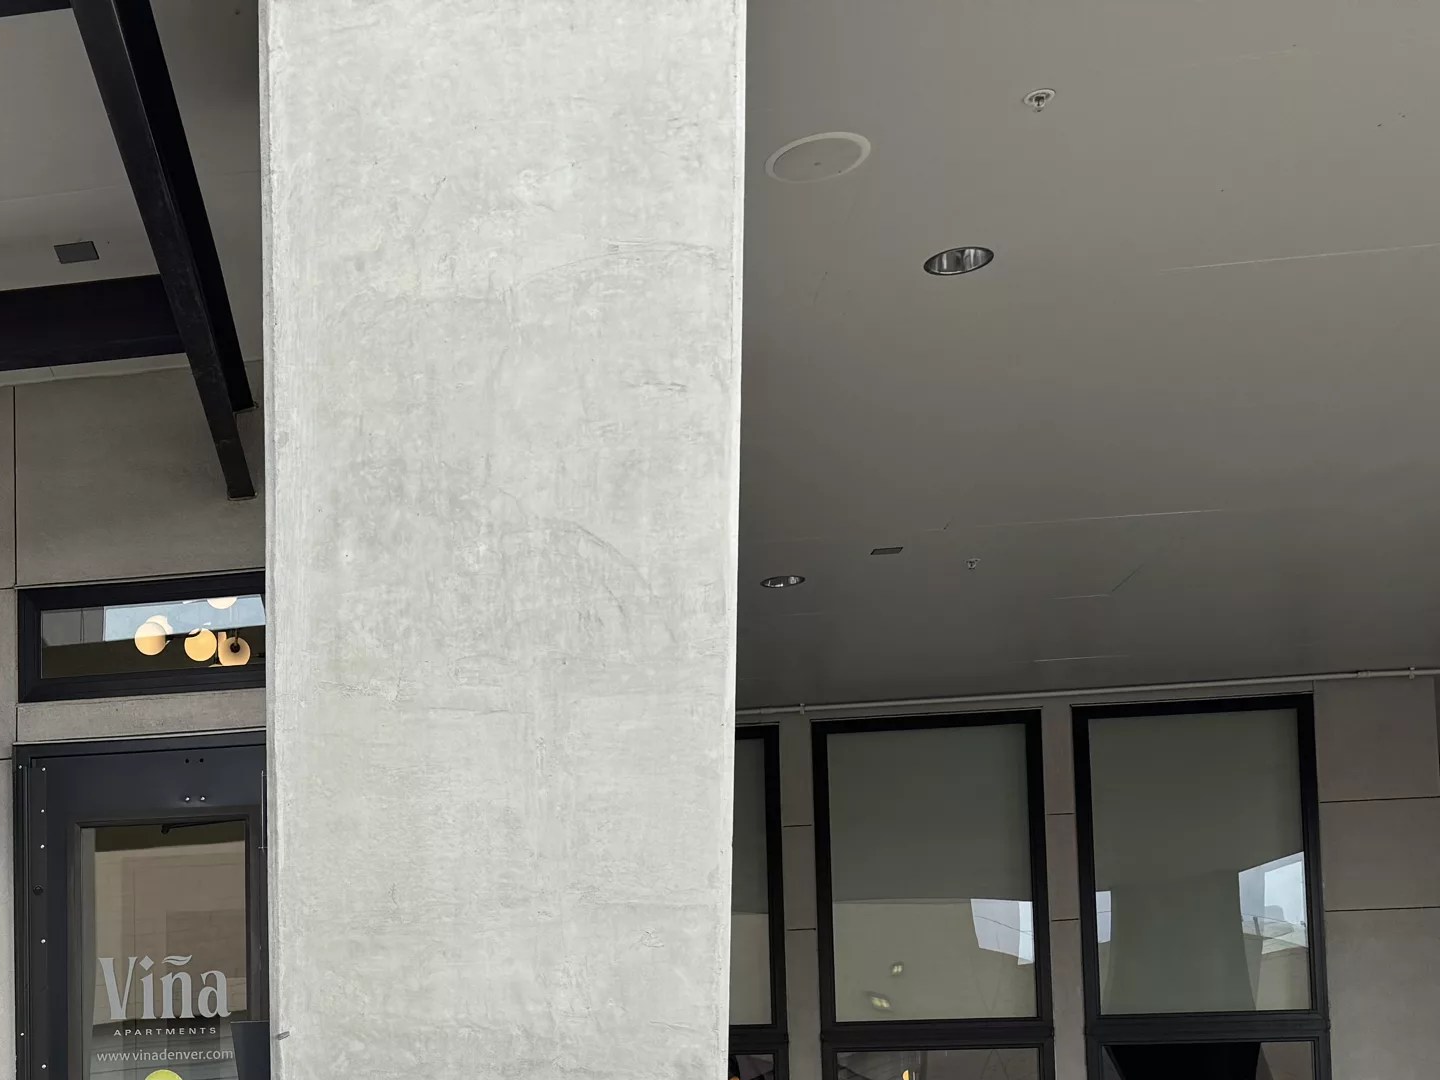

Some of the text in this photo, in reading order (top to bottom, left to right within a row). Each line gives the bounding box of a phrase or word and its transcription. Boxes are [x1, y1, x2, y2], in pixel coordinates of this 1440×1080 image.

[97, 954, 232, 1020] Viña
[113, 1026, 217, 1037] APARTMENTS
[96, 1048, 234, 1062] wwwvinadenver.com
